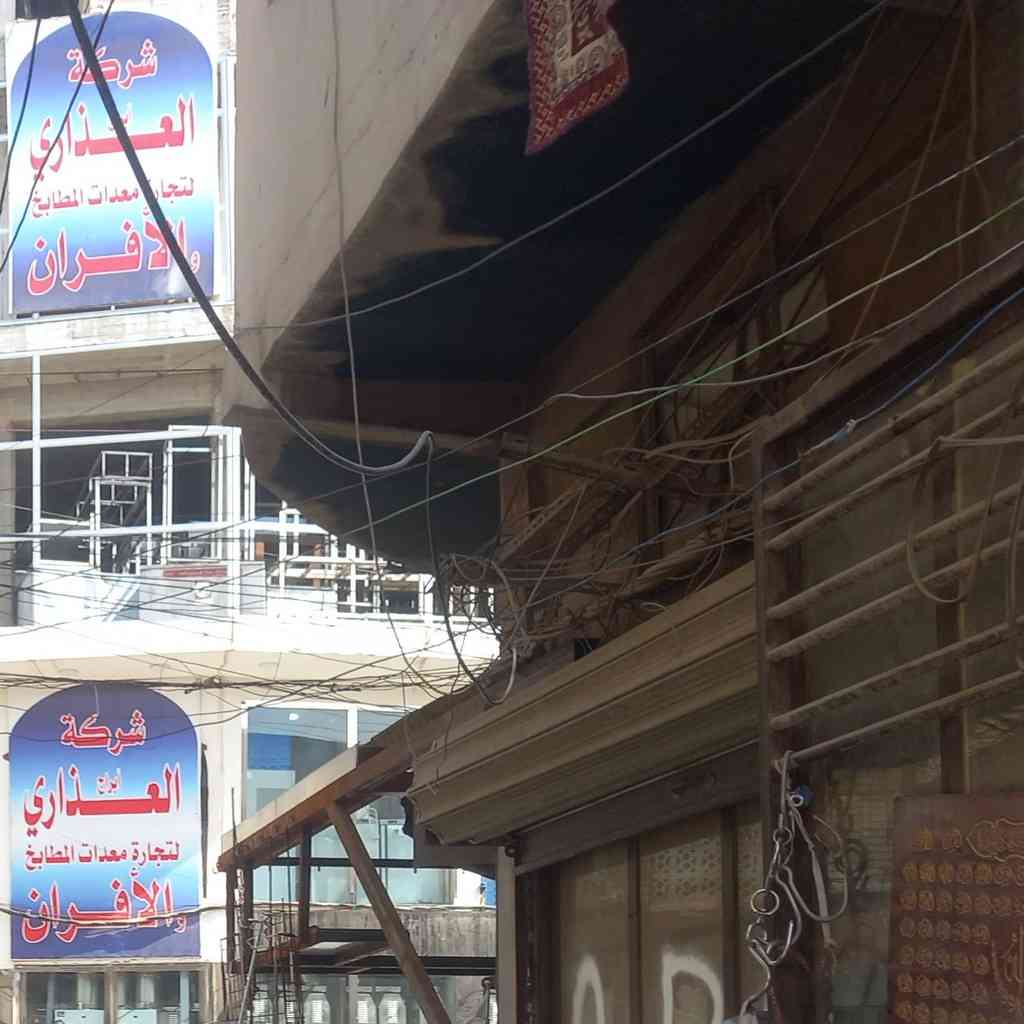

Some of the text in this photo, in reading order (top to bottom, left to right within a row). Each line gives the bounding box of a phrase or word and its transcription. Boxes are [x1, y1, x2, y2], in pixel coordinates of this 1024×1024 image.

[66, 39, 158, 89] شركة
[29, 94, 196, 182] العذاري
[32, 188, 84, 218] المطابخ
[88, 185, 139, 205] معدات
[60, 709, 146, 756] شركة
[23, 762, 183, 837] العذاري
[25, 841, 180, 871] لتجارة معدات المطابخ
